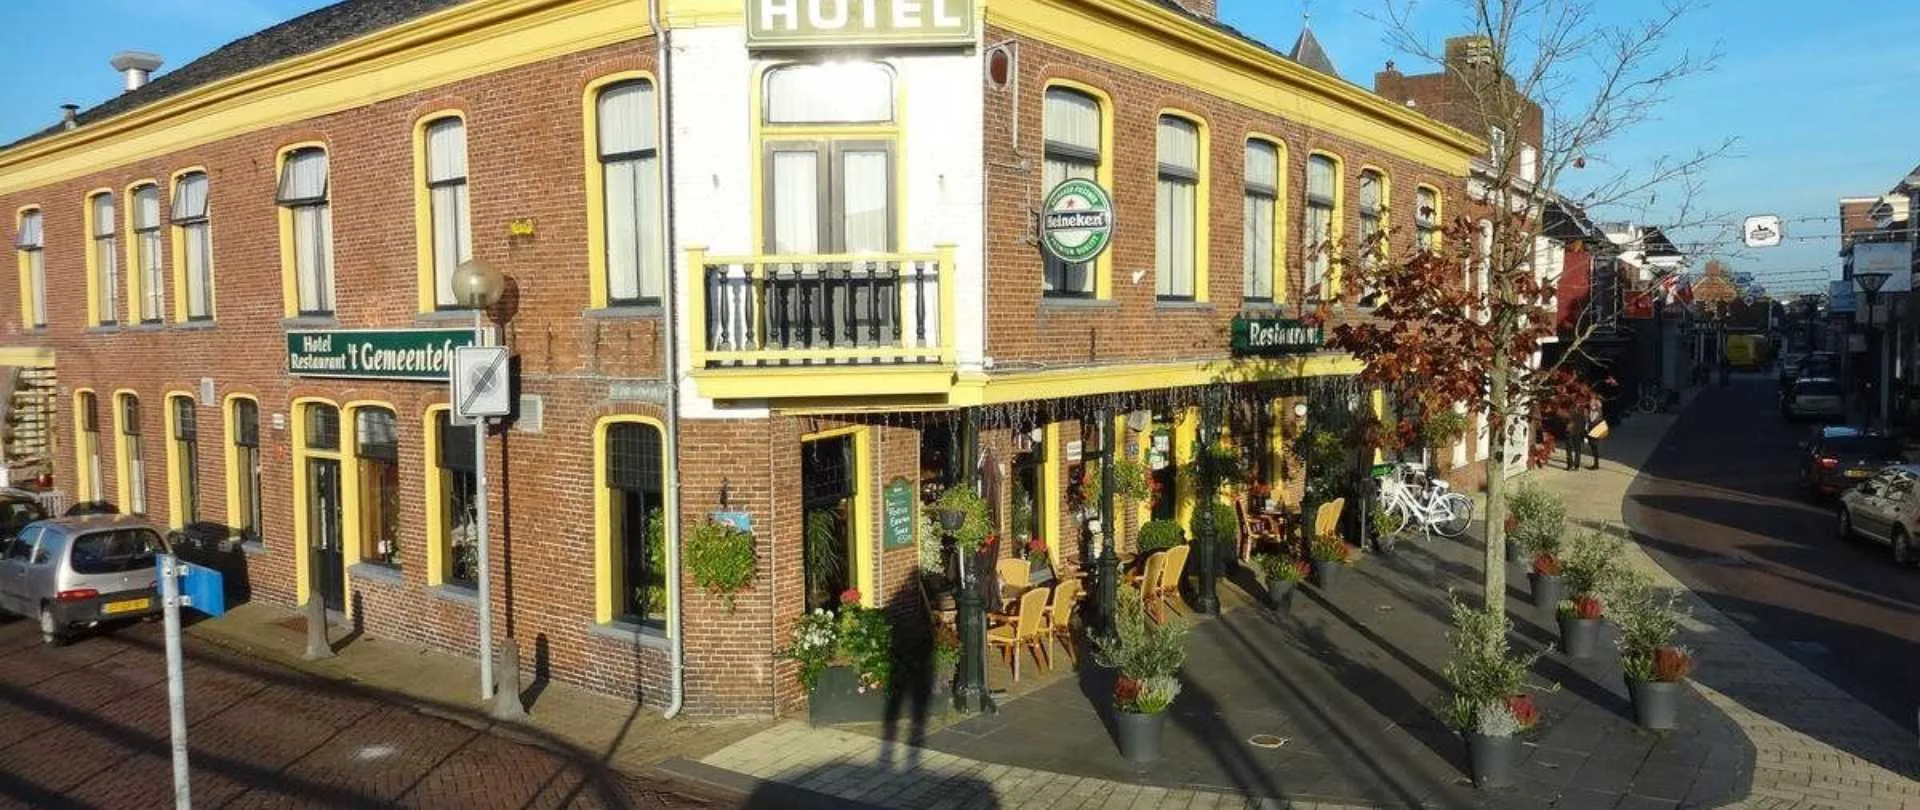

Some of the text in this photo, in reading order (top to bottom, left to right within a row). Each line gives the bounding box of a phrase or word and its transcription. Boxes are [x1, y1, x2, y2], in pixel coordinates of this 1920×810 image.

[761, 0, 961, 30] HOTEL
[1047, 213, 1103, 229] Heineken
[303, 335, 332, 352] Hotel
[1249, 321, 1318, 346] Restaurant
[291, 353, 346, 370] Restaurant
[347, 338, 473, 372] 't Gemeenteh
